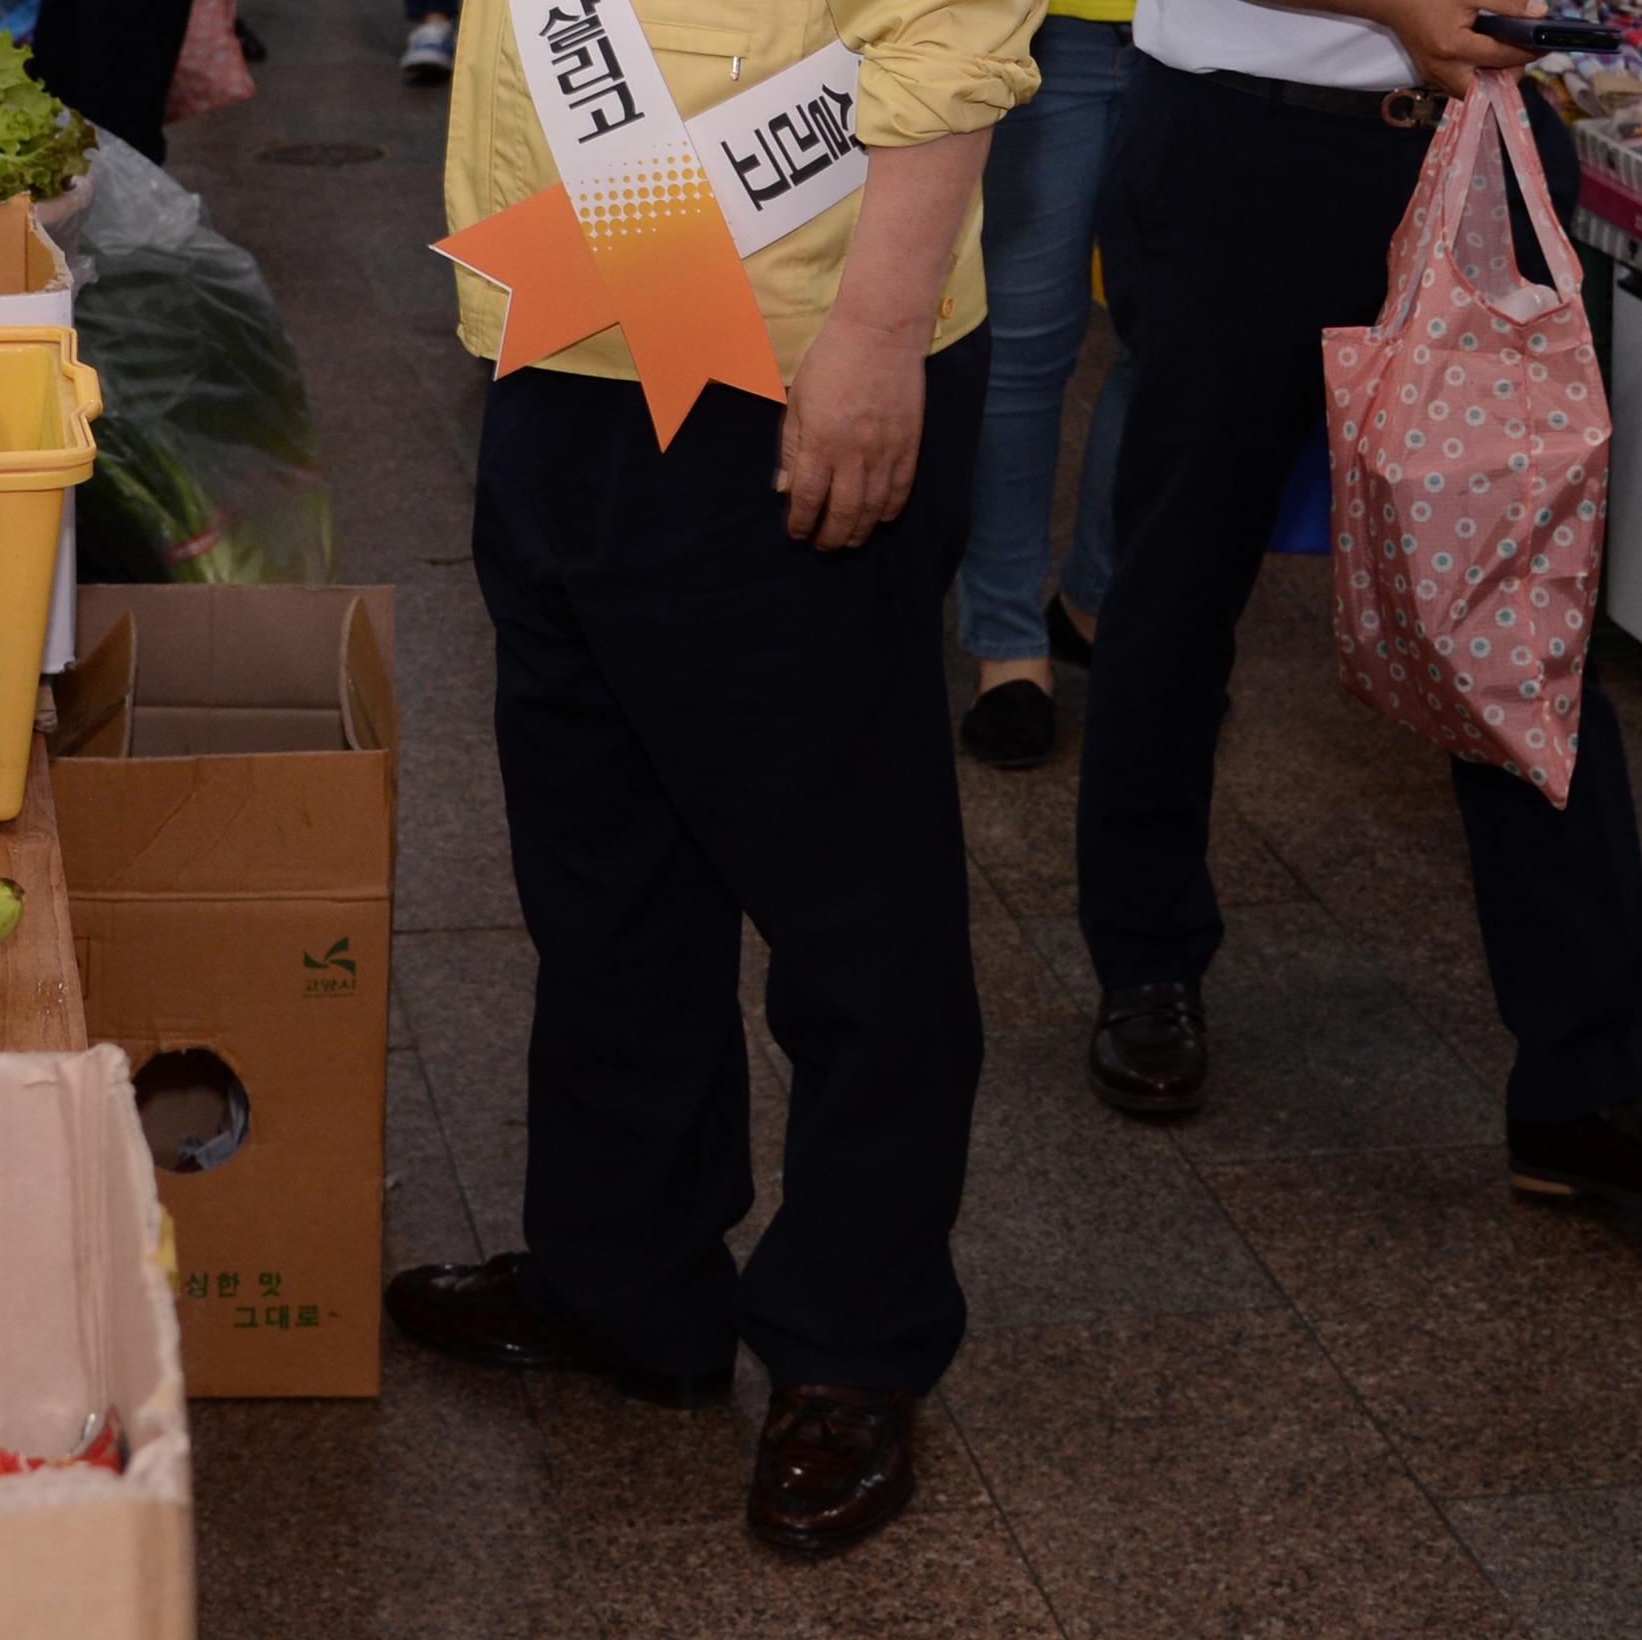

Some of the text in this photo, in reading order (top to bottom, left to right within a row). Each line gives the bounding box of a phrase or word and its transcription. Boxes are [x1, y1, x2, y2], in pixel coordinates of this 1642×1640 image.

[720, 82, 868, 211] 살리고
[184, 1271, 283, 1299] 싱한 맛
